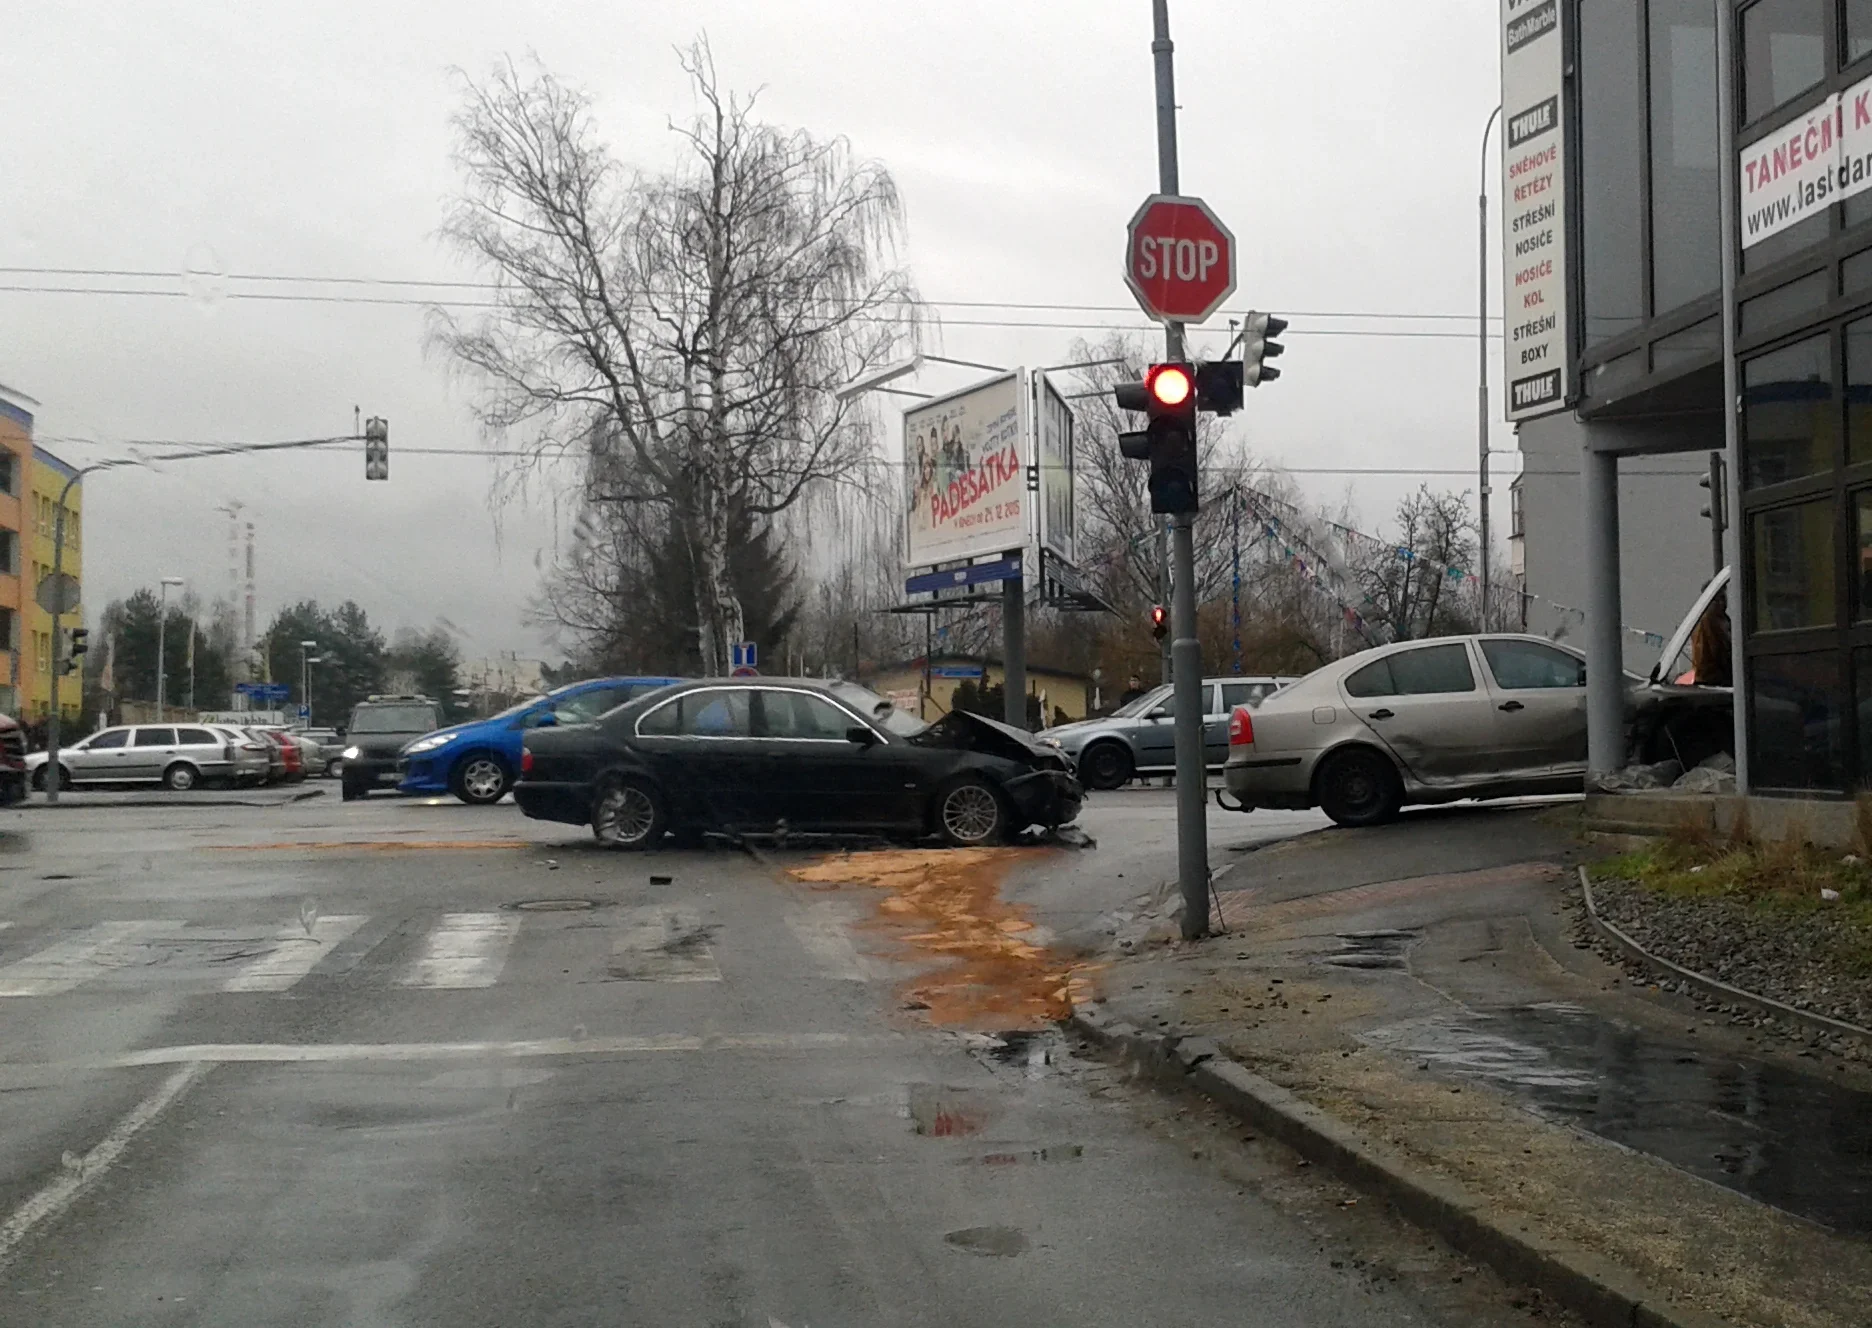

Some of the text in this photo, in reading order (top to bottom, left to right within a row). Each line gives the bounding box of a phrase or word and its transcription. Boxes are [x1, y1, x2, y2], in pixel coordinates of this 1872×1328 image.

[1511, 104, 1551, 142] THULE
[1745, 93, 1844, 194] TANEČNÍ
[1512, 199, 1555, 233] STŘEŠNÍ
[1140, 235, 1219, 282] STOP
[1515, 229, 1553, 257] NOSIČE
[1515, 259, 1553, 286] NOSIČE
[1523, 289, 1545, 308] KOL
[1513, 311, 1556, 342] STŘEŠNÍ
[1521, 343, 1549, 364] BOXY
[1514, 375, 1554, 405] THULE
[931, 442, 1019, 529] PADESÁTKA
